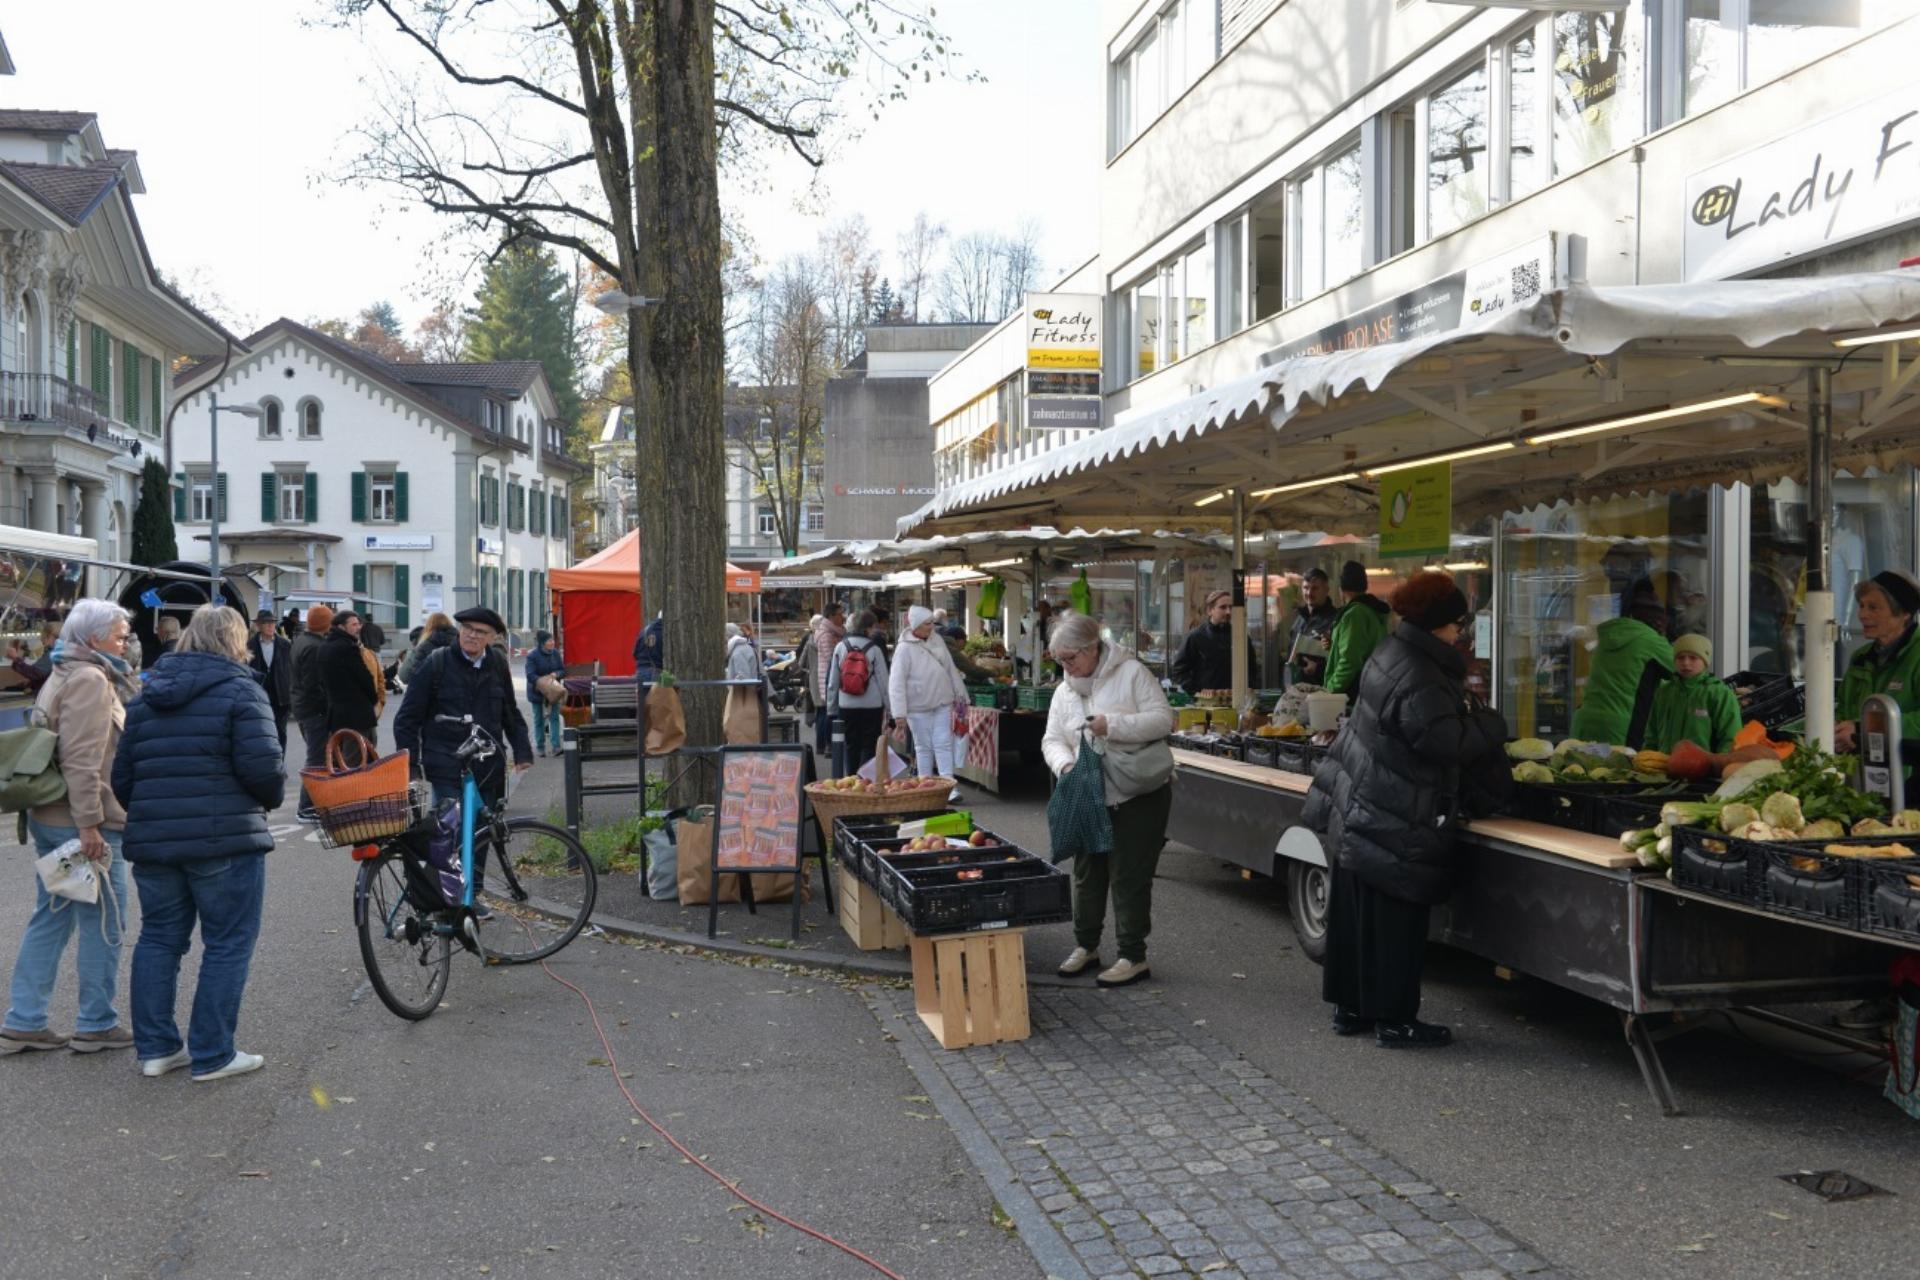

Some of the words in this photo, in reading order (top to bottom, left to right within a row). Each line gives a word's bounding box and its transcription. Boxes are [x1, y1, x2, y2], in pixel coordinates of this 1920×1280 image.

[1725, 152, 1854, 241] Lady
[1046, 309, 1093, 333] Lady
[1031, 327, 1097, 342] Fitness
[847, 487, 896, 495] SCHWEND
